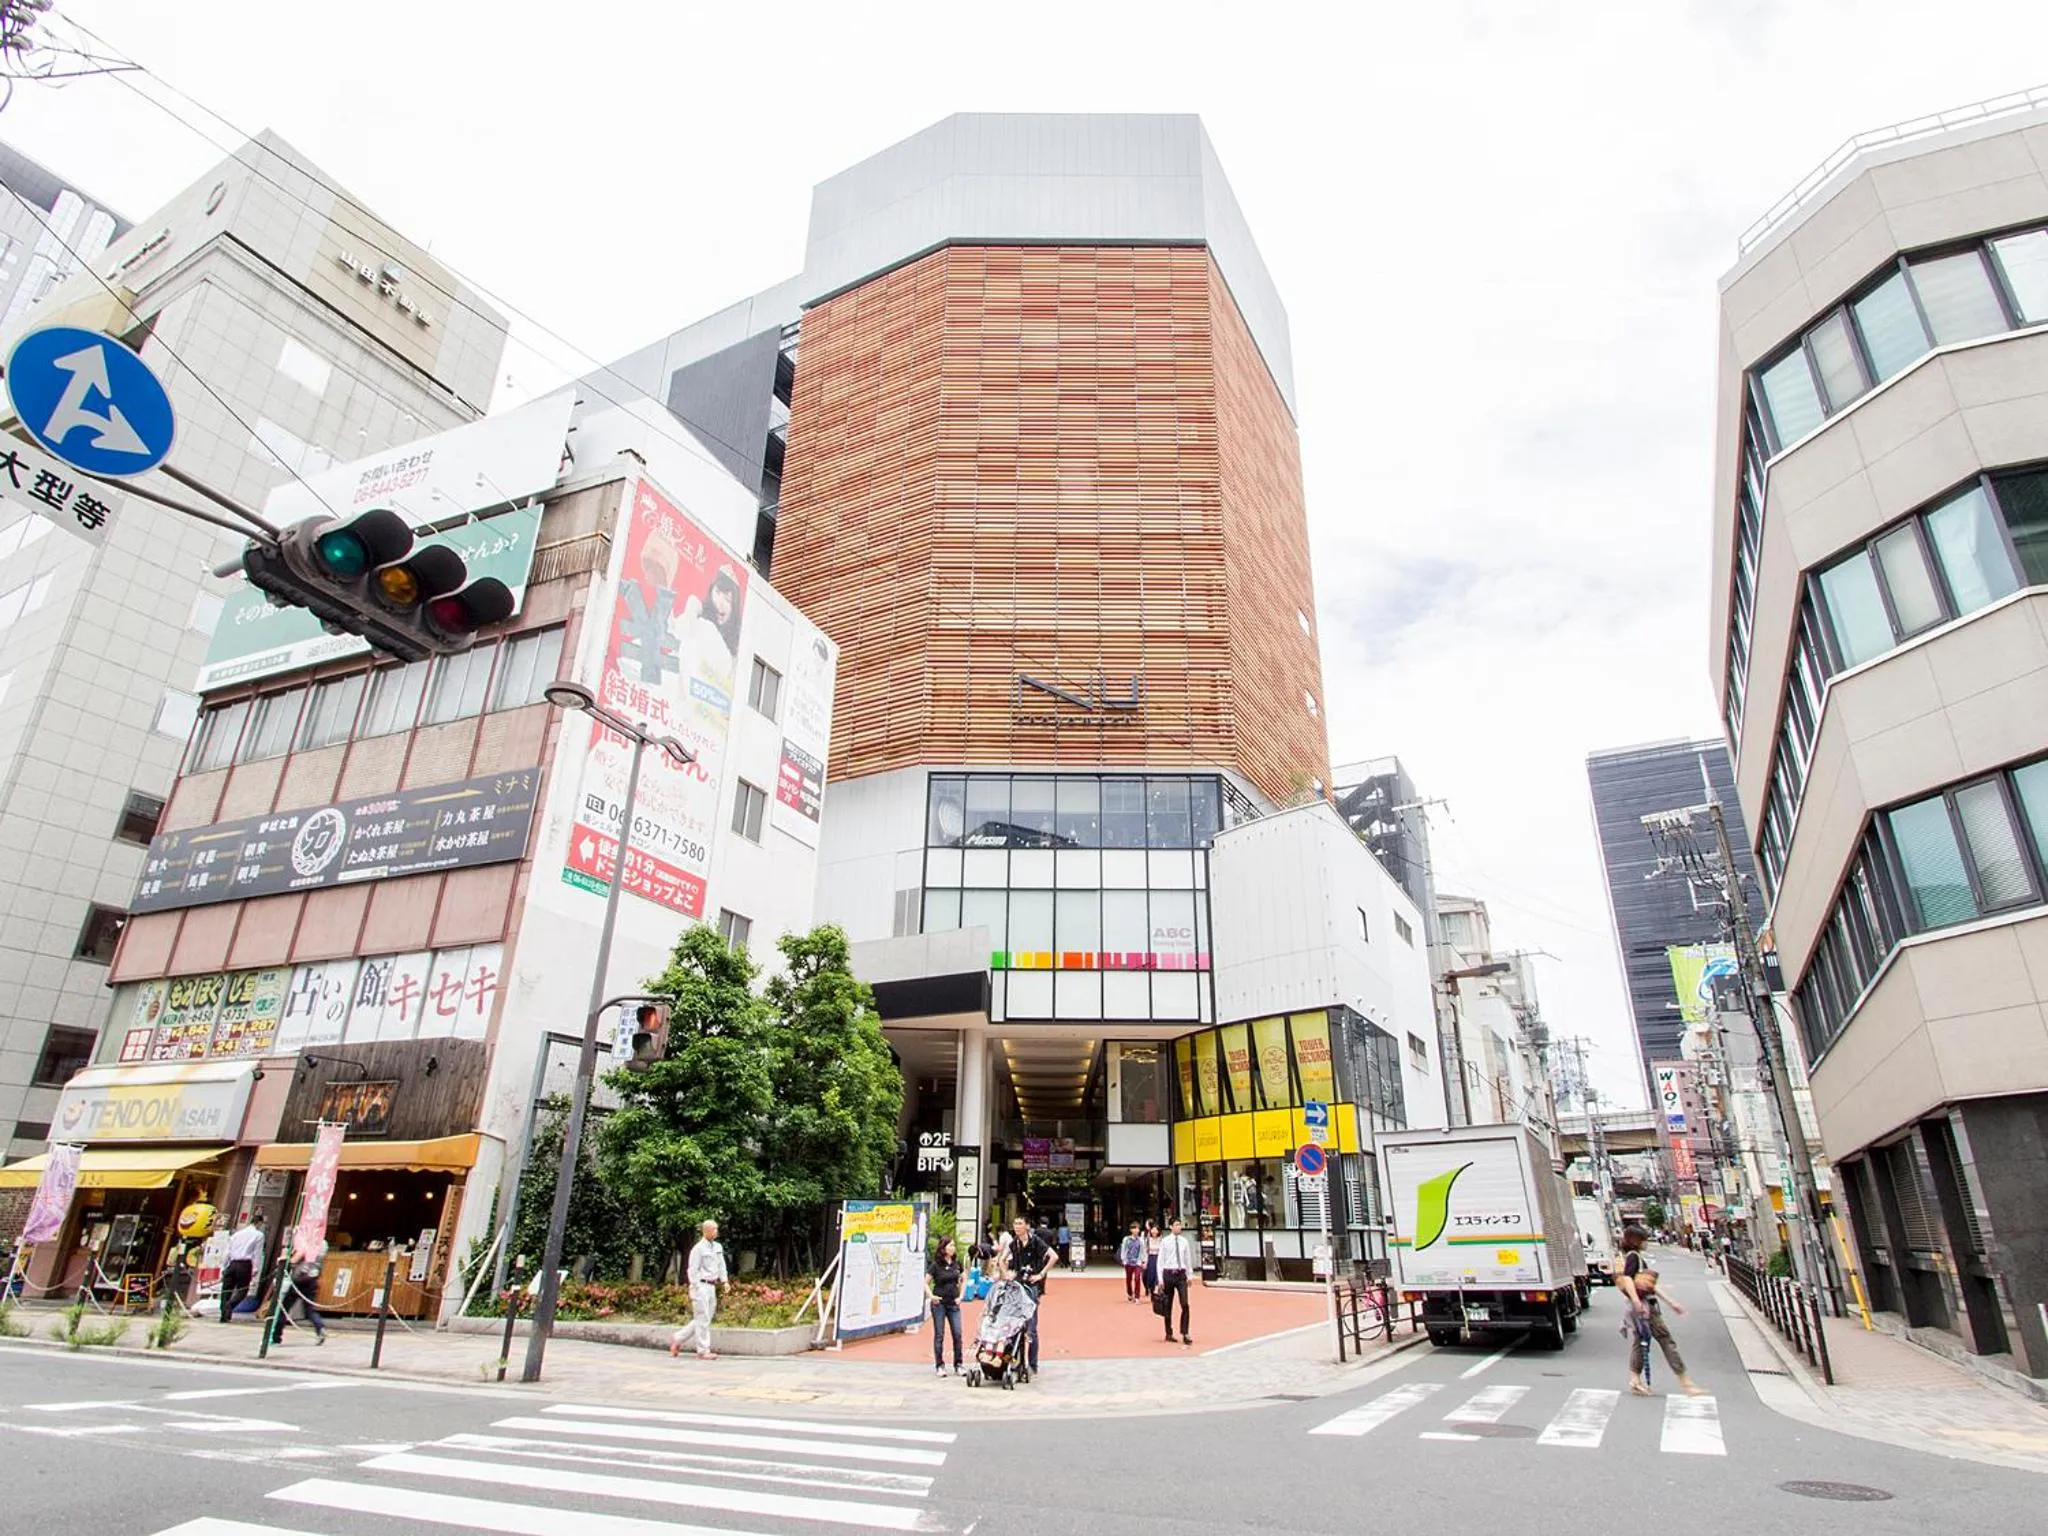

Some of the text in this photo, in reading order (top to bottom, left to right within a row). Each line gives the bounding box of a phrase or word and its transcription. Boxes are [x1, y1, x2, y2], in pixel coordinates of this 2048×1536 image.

[0, 451, 111, 529] 大型等
[606, 670, 669, 726] 結婚式
[493, 775, 532, 794] ミナミ
[440, 804, 497, 828] 力丸茶屋
[608, 803, 706, 862] 066371-7580
[1153, 927, 1191, 939] ABC
[1297, 1038, 1325, 1051] TOWER
[1659, 1071, 1677, 1110] WAO!
[87, 1097, 221, 1130] TENDON ASAHI
[932, 1132, 951, 1146] 2F
[917, 1157, 941, 1171] B1F
